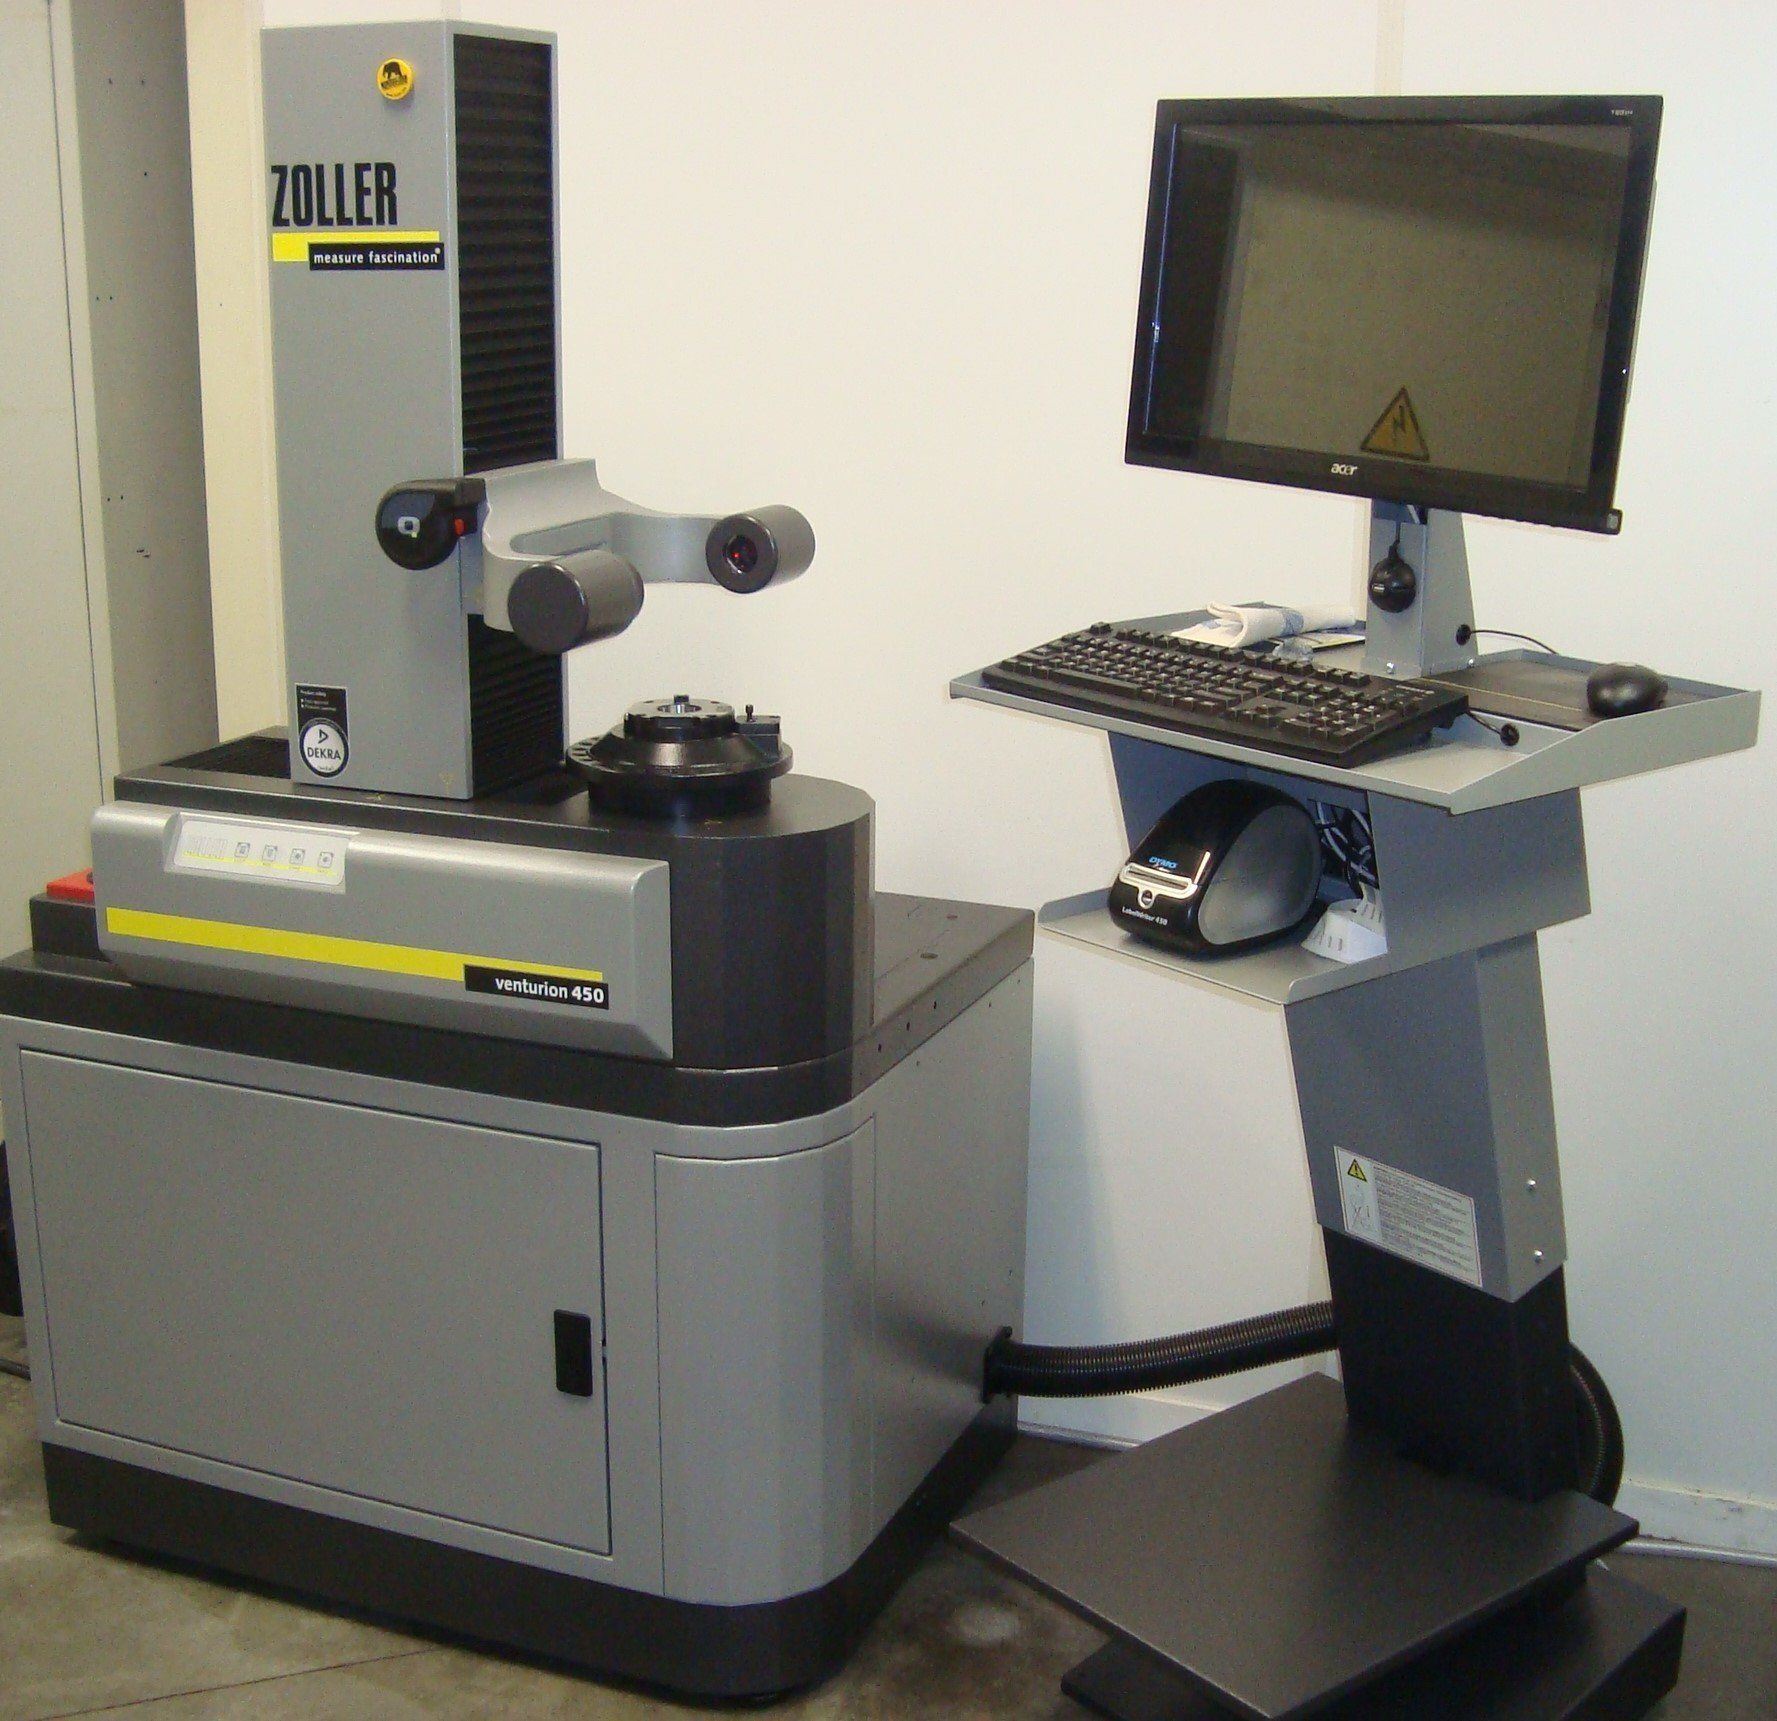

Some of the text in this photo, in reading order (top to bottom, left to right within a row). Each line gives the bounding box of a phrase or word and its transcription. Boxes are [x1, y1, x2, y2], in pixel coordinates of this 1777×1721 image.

[271, 162, 398, 227] ZOLLER
[313, 252, 364, 264] measure
[1331, 463, 1358, 476] acer
[307, 746, 342, 761] DEKRA
[1148, 856, 1177, 869] DYMO
[494, 977, 605, 1003] venturion 450
